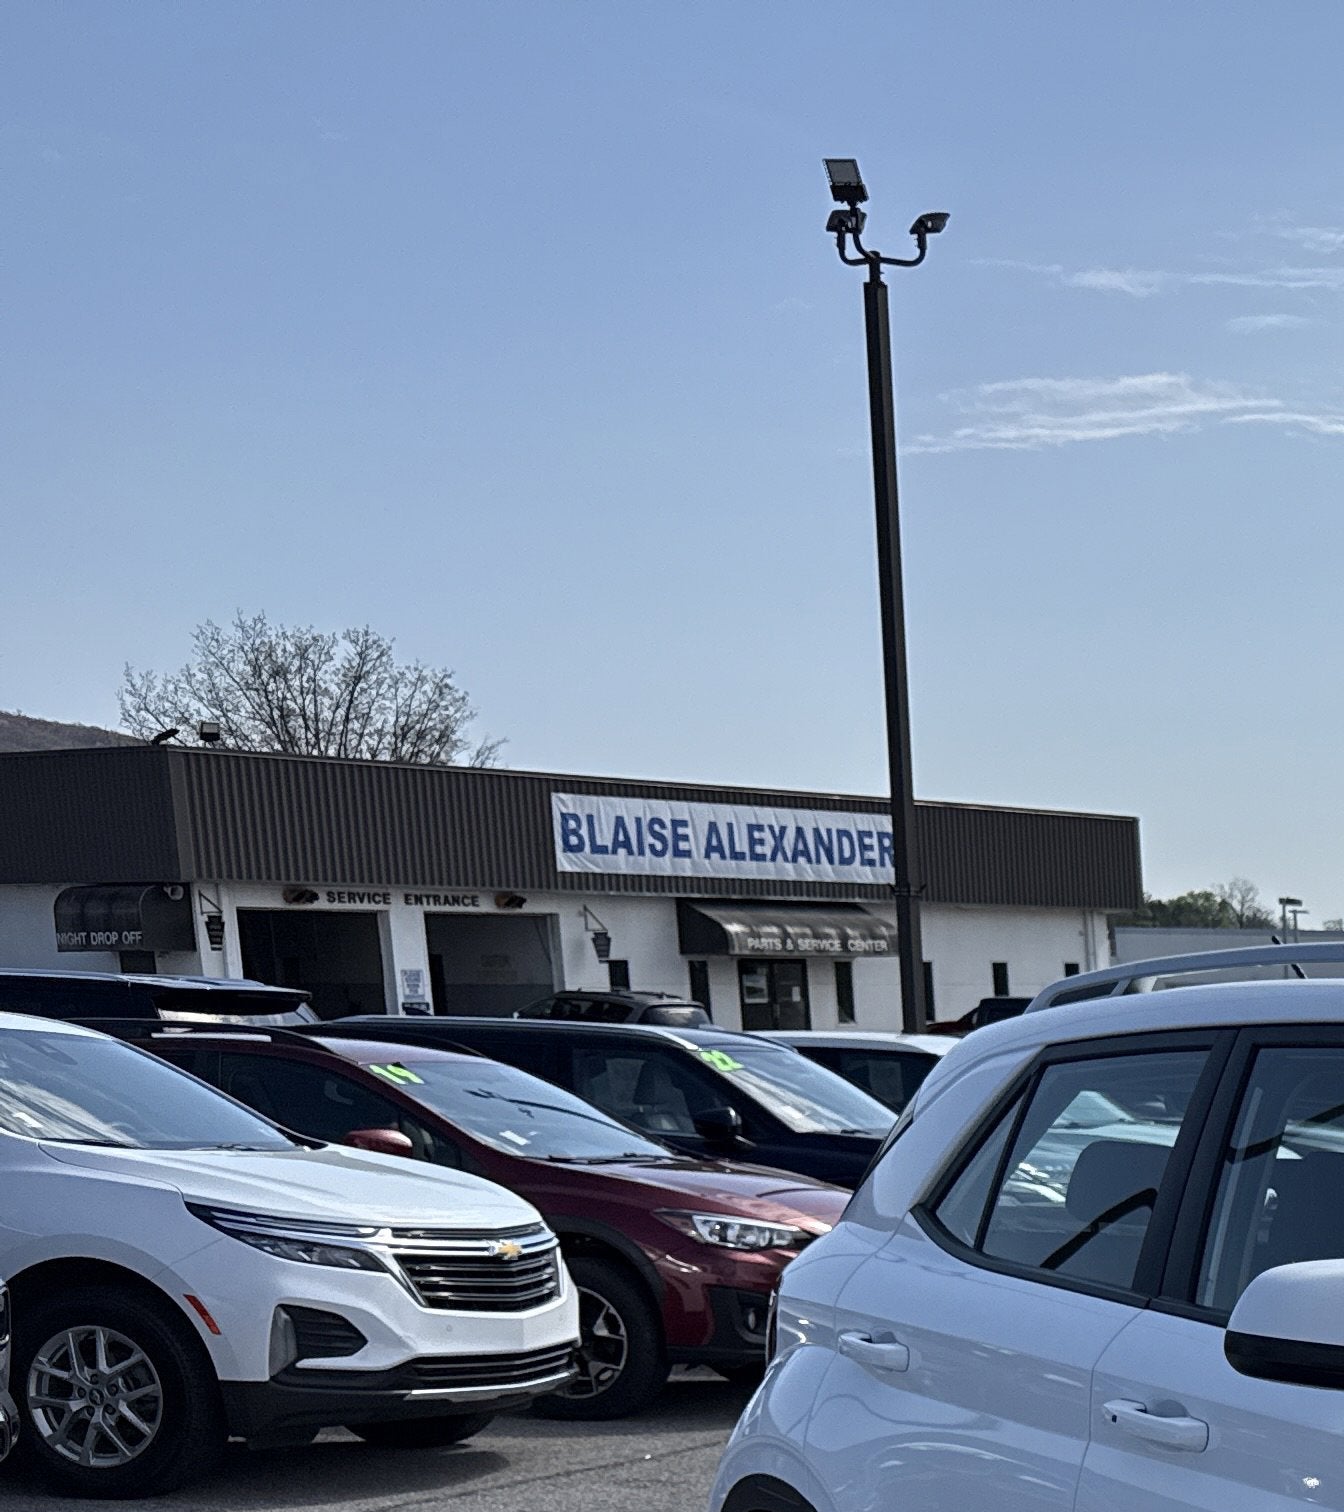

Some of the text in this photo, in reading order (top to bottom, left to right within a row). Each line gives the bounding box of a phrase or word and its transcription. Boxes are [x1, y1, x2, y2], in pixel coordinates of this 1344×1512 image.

[560, 812, 896, 868] BLAISE ALEXANDER
[326, 891, 480, 908] SERVICE ENTRANCE
[56, 930, 143, 945] NIGHT DROP OFF
[747, 937, 889, 952] PARTS & SERVICE CENTER
